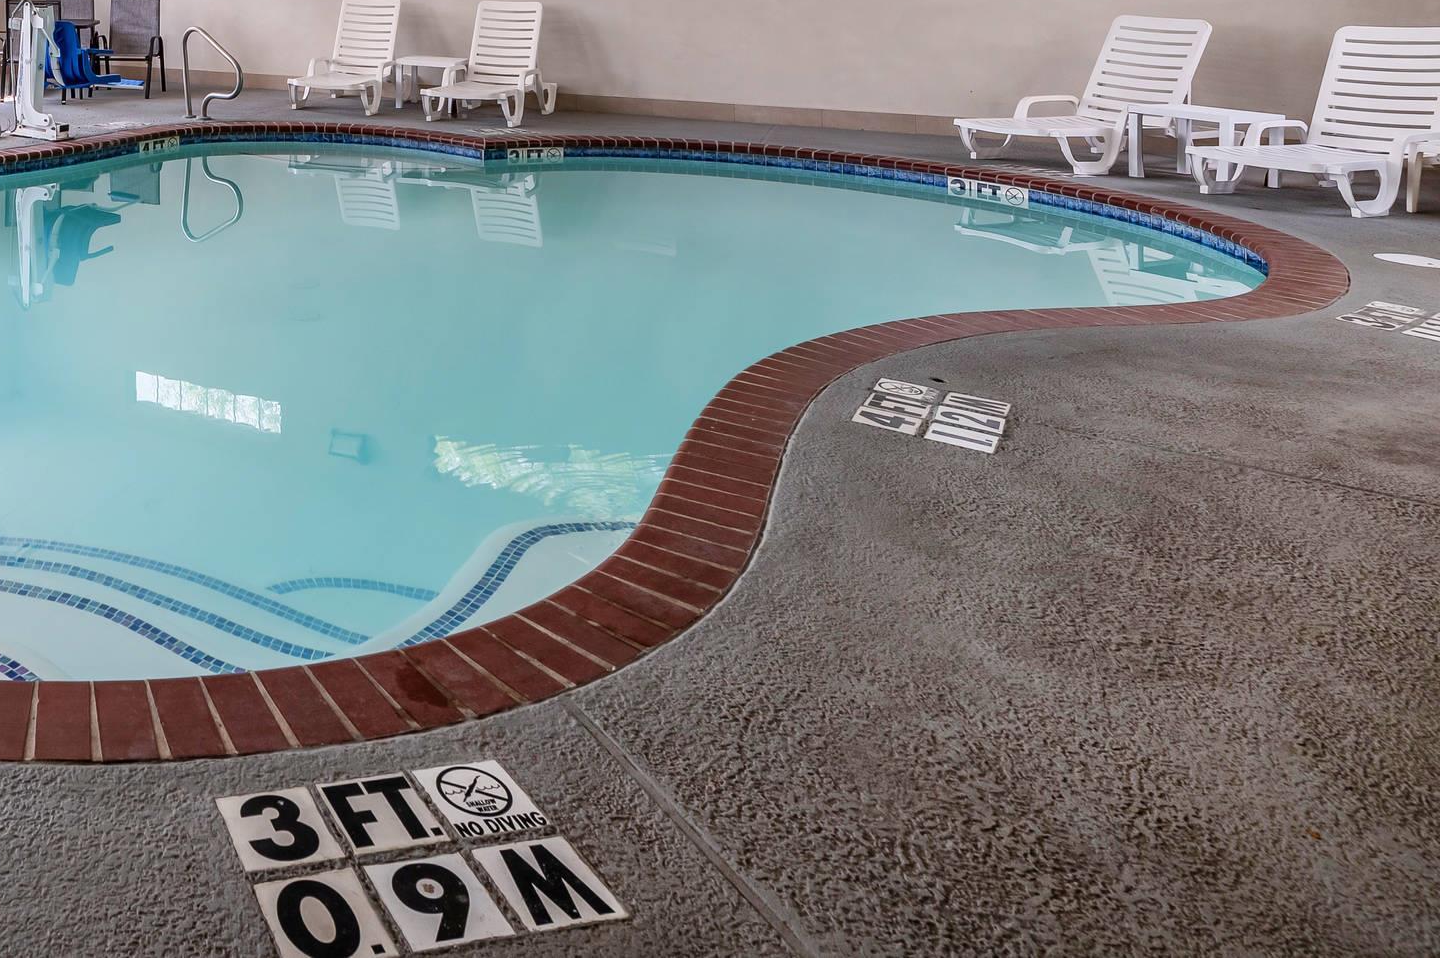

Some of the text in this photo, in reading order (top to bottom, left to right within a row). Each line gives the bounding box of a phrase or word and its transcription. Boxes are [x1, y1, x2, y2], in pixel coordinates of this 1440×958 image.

[949, 394, 1009, 415] M
[859, 410, 916, 429] 4
[465, 798, 497, 808] SHALLOW
[476, 804, 499, 812] WATER
[240, 776, 445, 862] 3 FT.
[453, 812, 548, 838] NO DIVING
[499, 844, 614, 926] M
